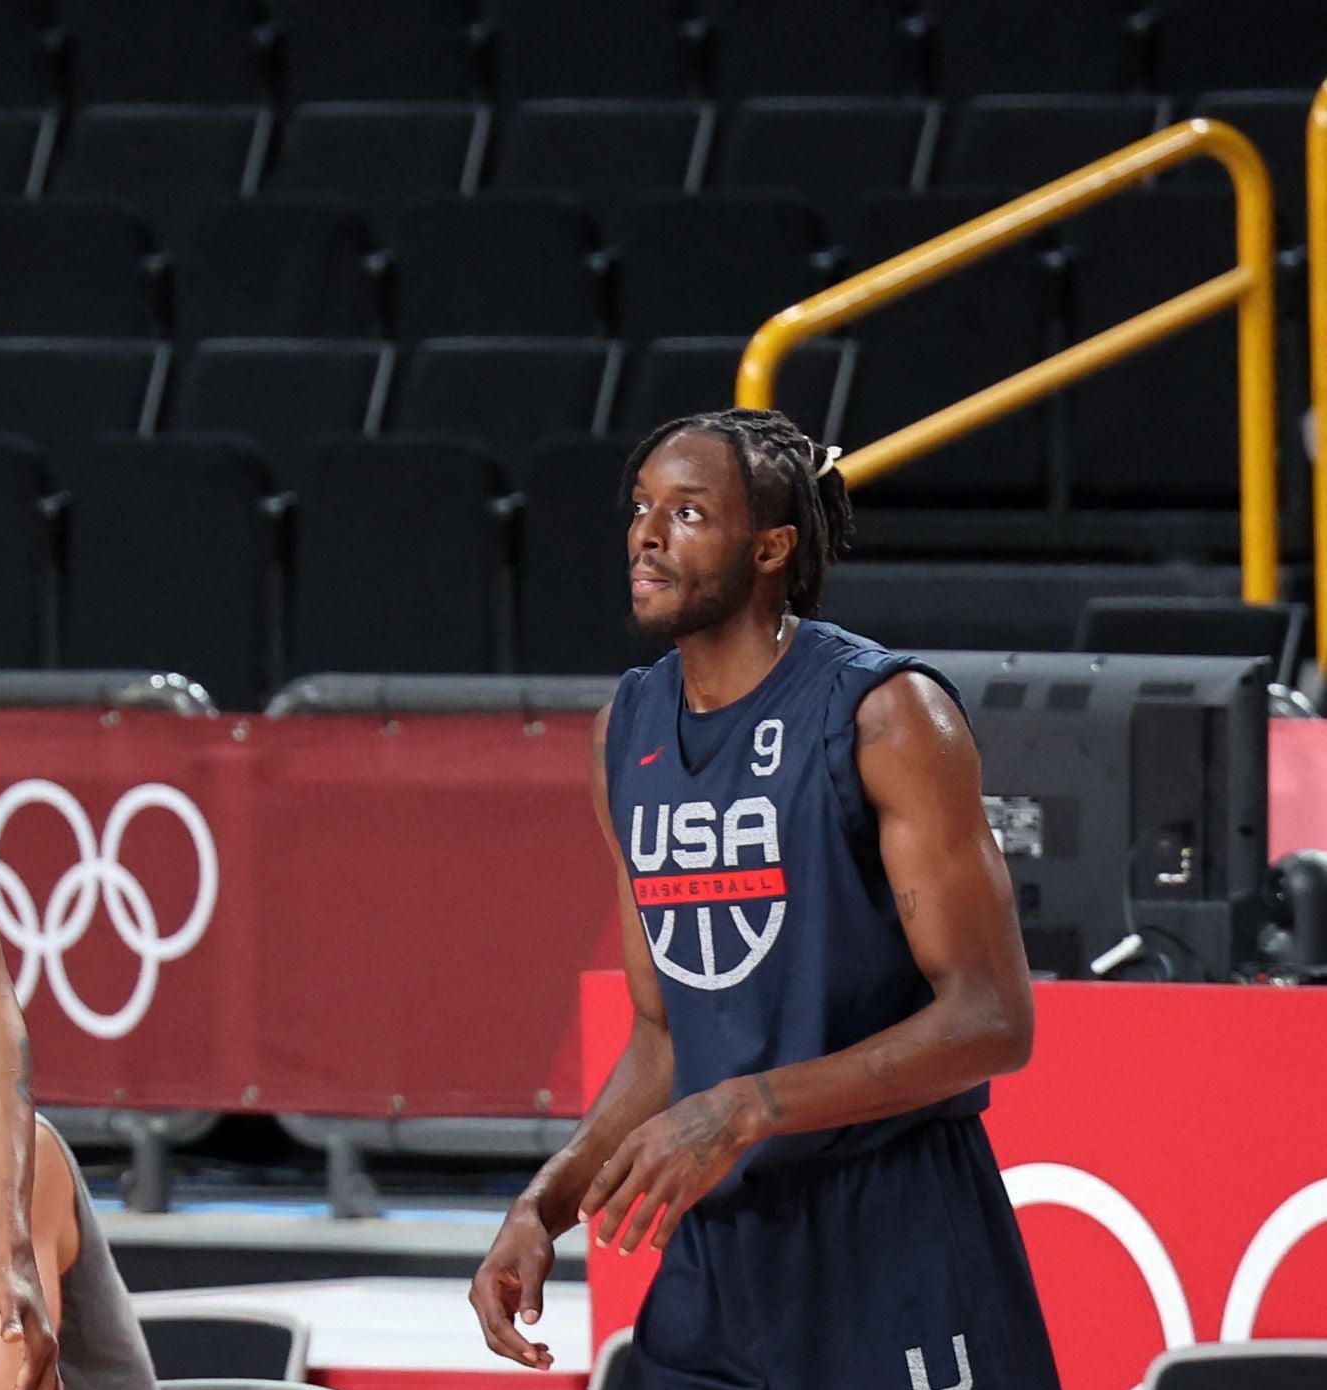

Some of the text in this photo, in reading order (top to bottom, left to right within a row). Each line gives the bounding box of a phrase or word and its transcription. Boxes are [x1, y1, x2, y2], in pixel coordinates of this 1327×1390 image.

[751, 718, 785, 777] 9
[630, 796, 781, 872] USA
[639, 875, 773, 898] BASKETBALL
